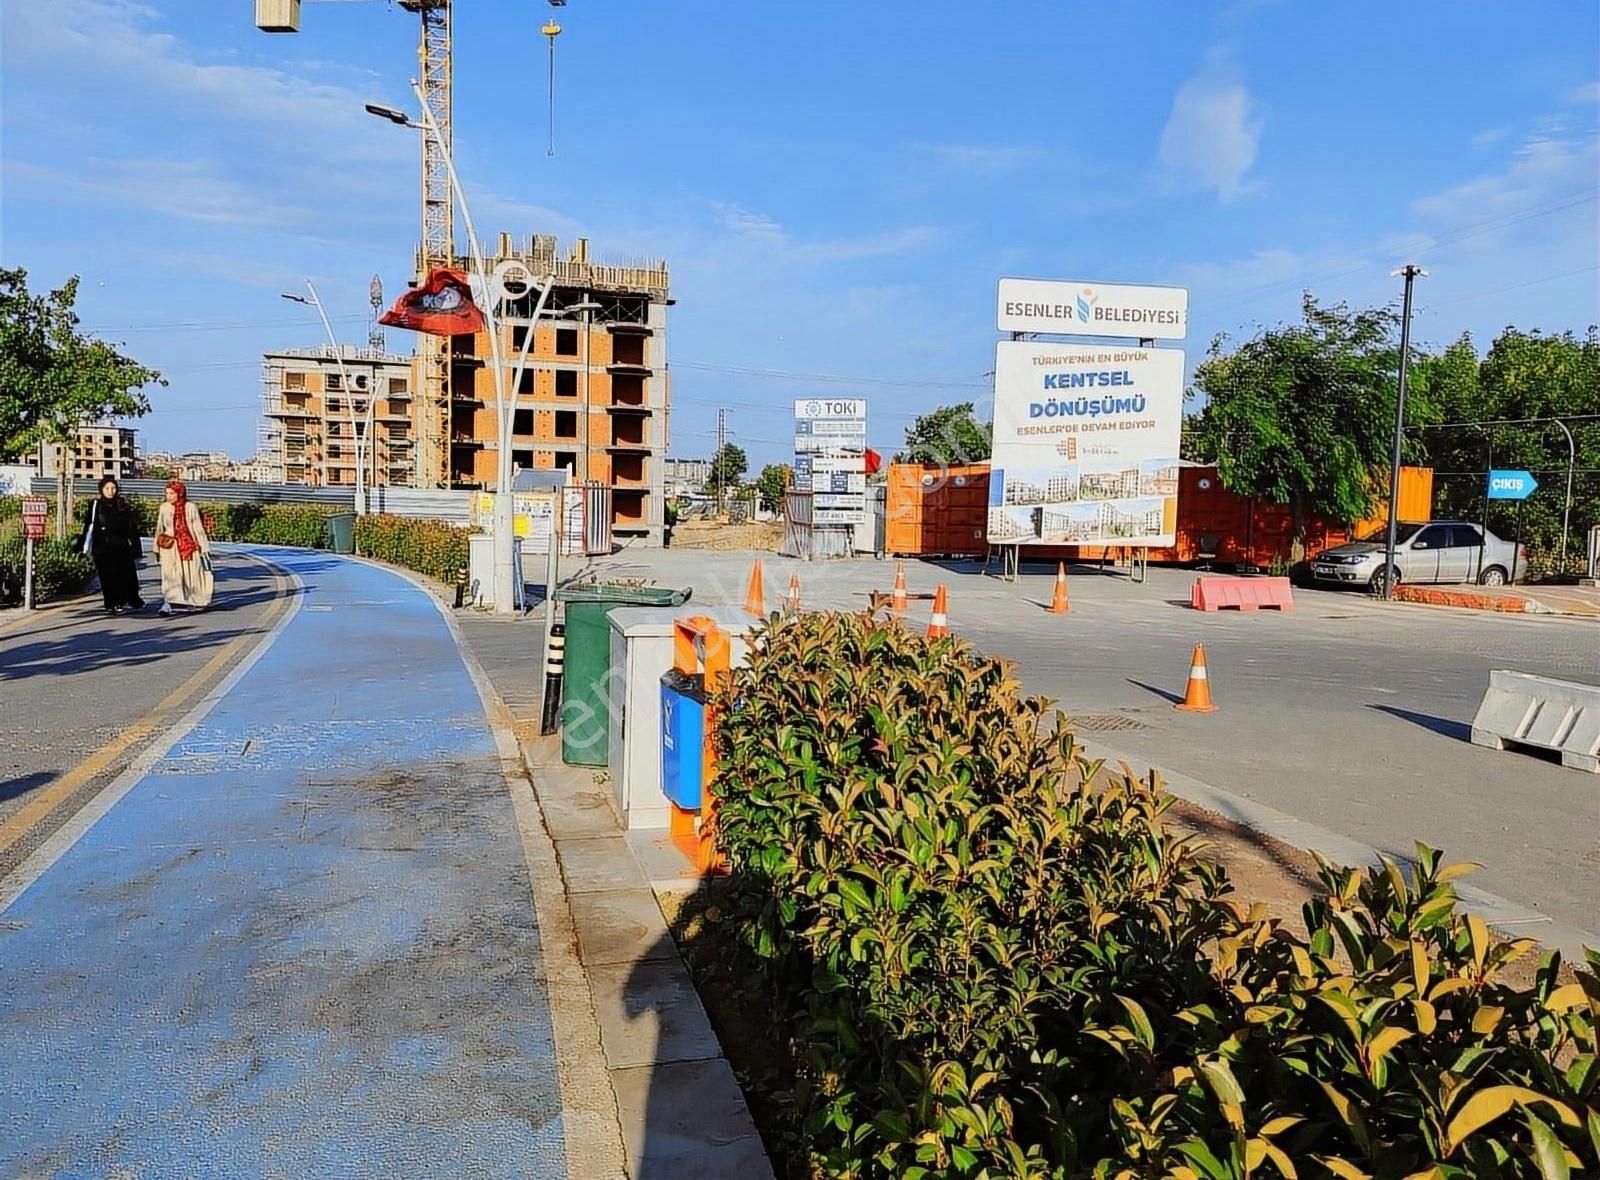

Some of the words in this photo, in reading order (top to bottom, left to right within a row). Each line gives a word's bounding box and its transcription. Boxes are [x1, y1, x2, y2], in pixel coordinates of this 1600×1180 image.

[1005, 302, 1073, 319] ESENLER
[1094, 307, 1179, 324] BELEDİYESİ
[1098, 353, 1112, 363] EN
[1113, 352, 1148, 363] BÜYÜK
[1044, 371, 1134, 389] KENTSEL
[1029, 394, 1146, 418] DÖNÜŞÜMÜ
[1016, 425, 1079, 436] ESENLER'DE
[1082, 422, 1117, 433] DEVAM
[1119, 420, 1156, 430] EDİYOR
[1492, 479, 1524, 491] ÇIKIŞ
